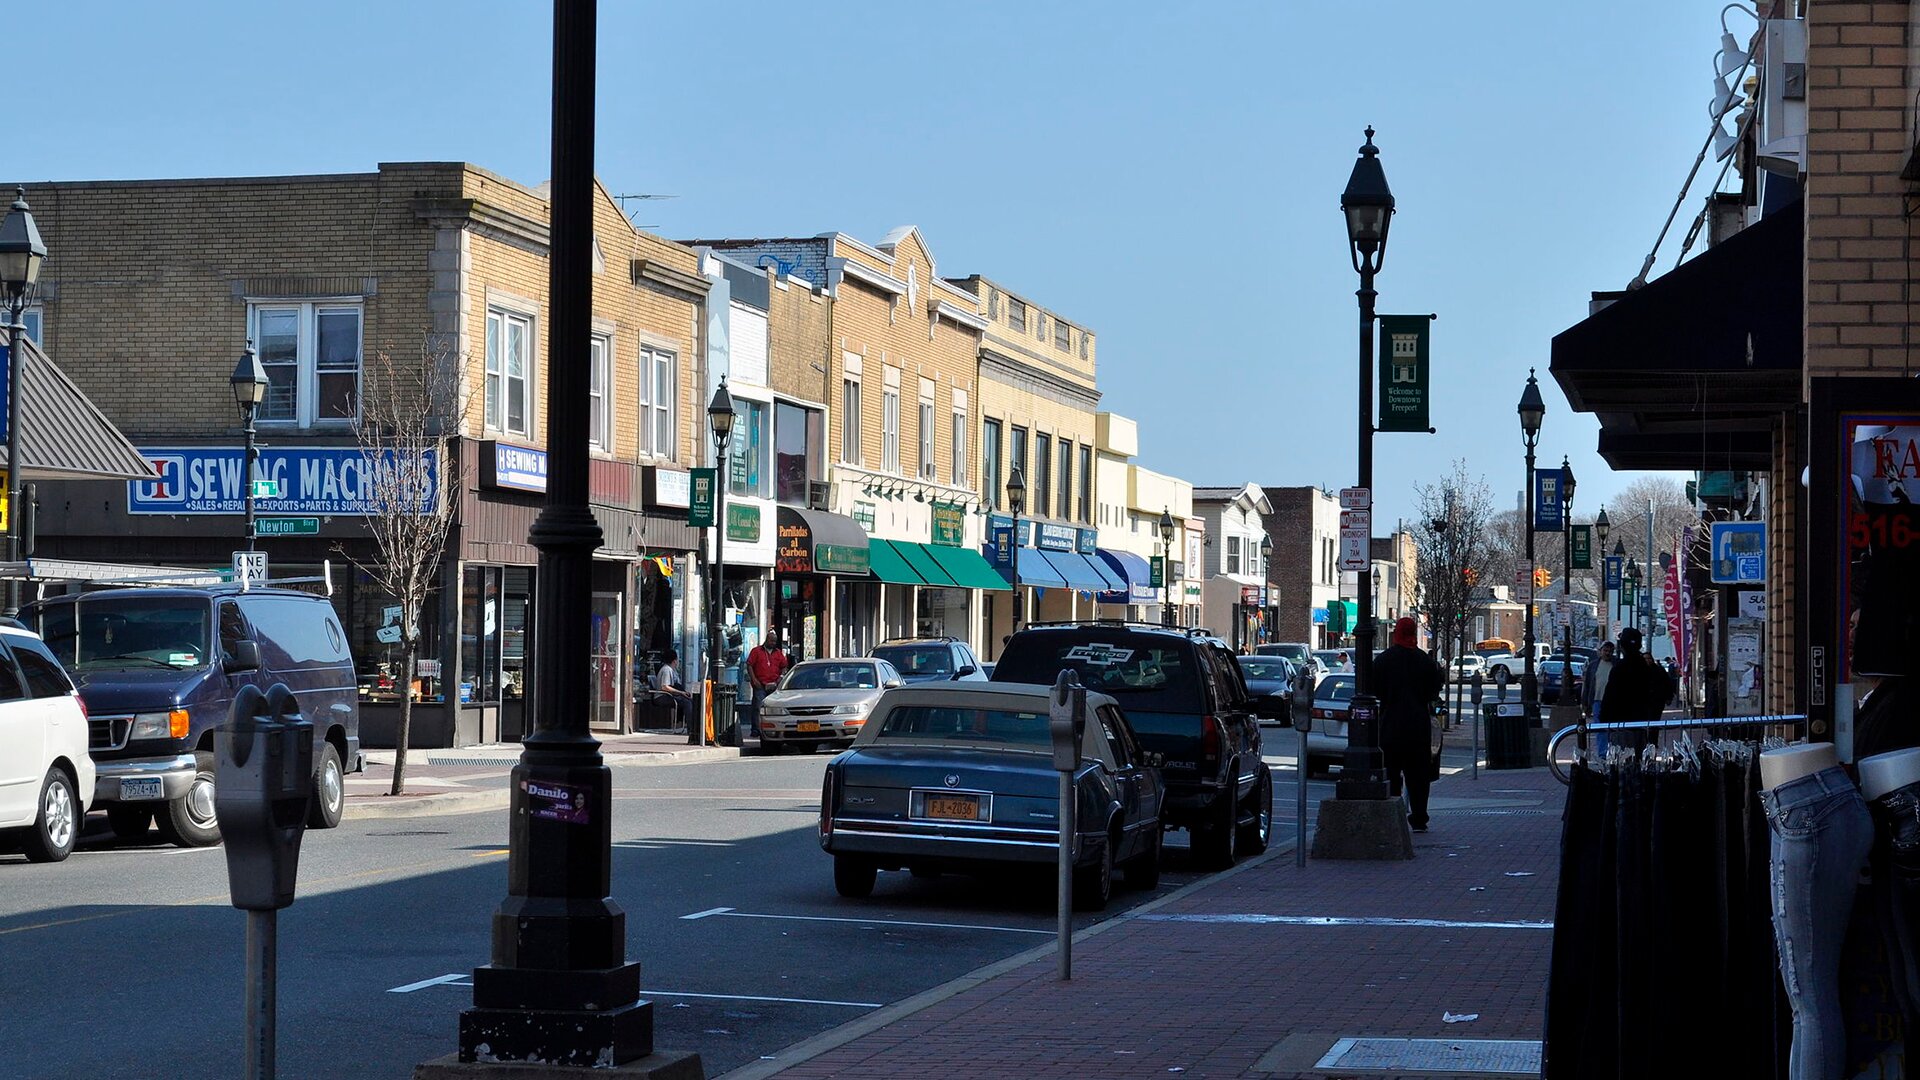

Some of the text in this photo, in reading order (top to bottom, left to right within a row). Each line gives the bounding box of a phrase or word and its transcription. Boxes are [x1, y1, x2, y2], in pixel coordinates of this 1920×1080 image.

[1388, 387, 1414, 395] Welcome
[1391, 404, 1418, 413] Freeport
[506, 448, 537, 473] SEWING
[190, 457, 288, 500] SEWNG
[191, 500, 217, 511] SALES
[262, 501, 299, 511] EXPORTS
[306, 501, 331, 512] PARTS
[333, 501, 339, 511] &
[259, 520, 295, 532] Newton
[779, 525, 808, 538] Parrilladas
[1342, 530, 1367, 538] MIDNIGHT
[790, 538, 799, 548] al
[1075, 649, 1127, 658] TAHOE
[528, 784, 569, 800] Danilo
[931, 800, 972, 815] FJL-2036
